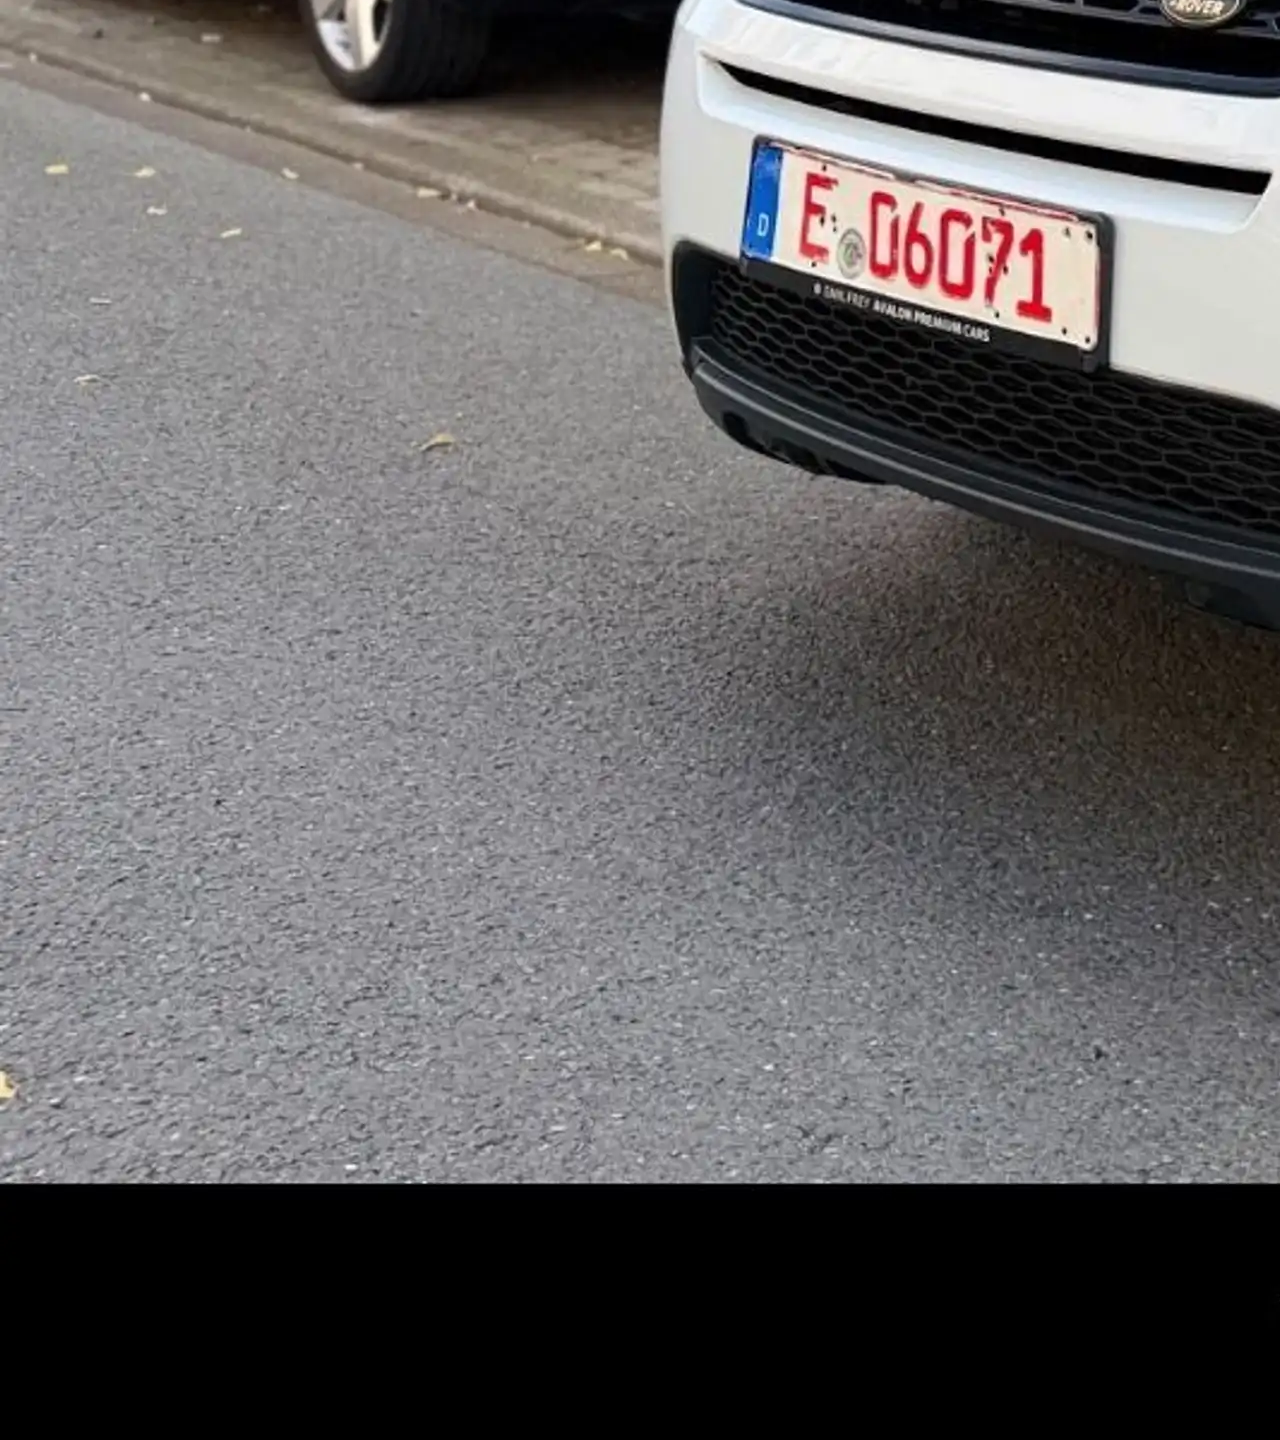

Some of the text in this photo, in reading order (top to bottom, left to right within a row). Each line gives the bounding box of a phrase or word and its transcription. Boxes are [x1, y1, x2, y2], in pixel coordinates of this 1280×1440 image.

[757, 171, 1053, 324] D E 06071
[914, 310, 962, 336] PREMIUM
[963, 323, 990, 343] CARS
